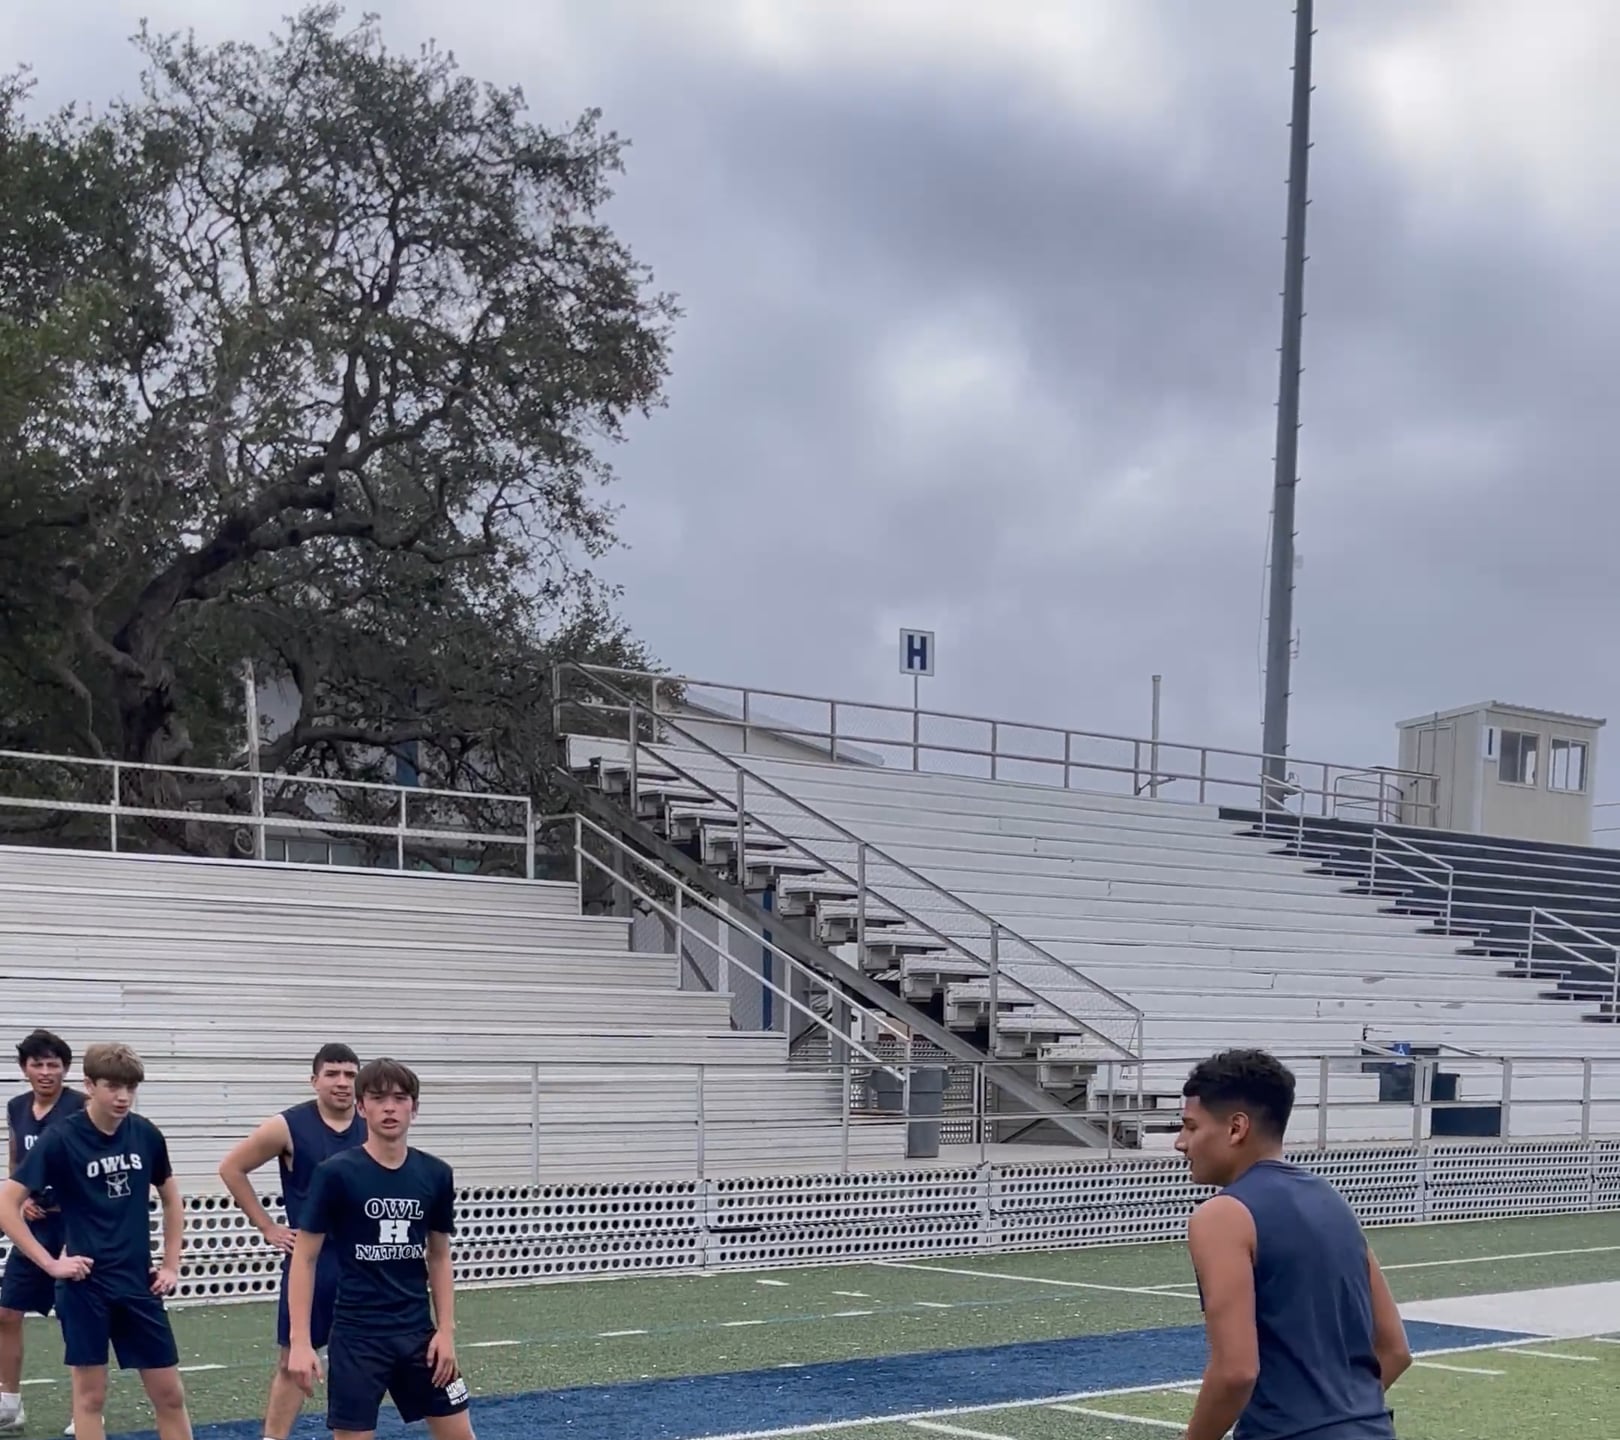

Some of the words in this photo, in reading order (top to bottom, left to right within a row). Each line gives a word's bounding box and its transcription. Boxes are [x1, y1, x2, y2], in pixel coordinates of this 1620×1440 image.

[907, 634, 927, 670] H
[86, 1153, 143, 1178] OWLS
[364, 1197, 424, 1220] OWL
[378, 1219, 411, 1243] H
[355, 1244, 425, 1261] NATION
